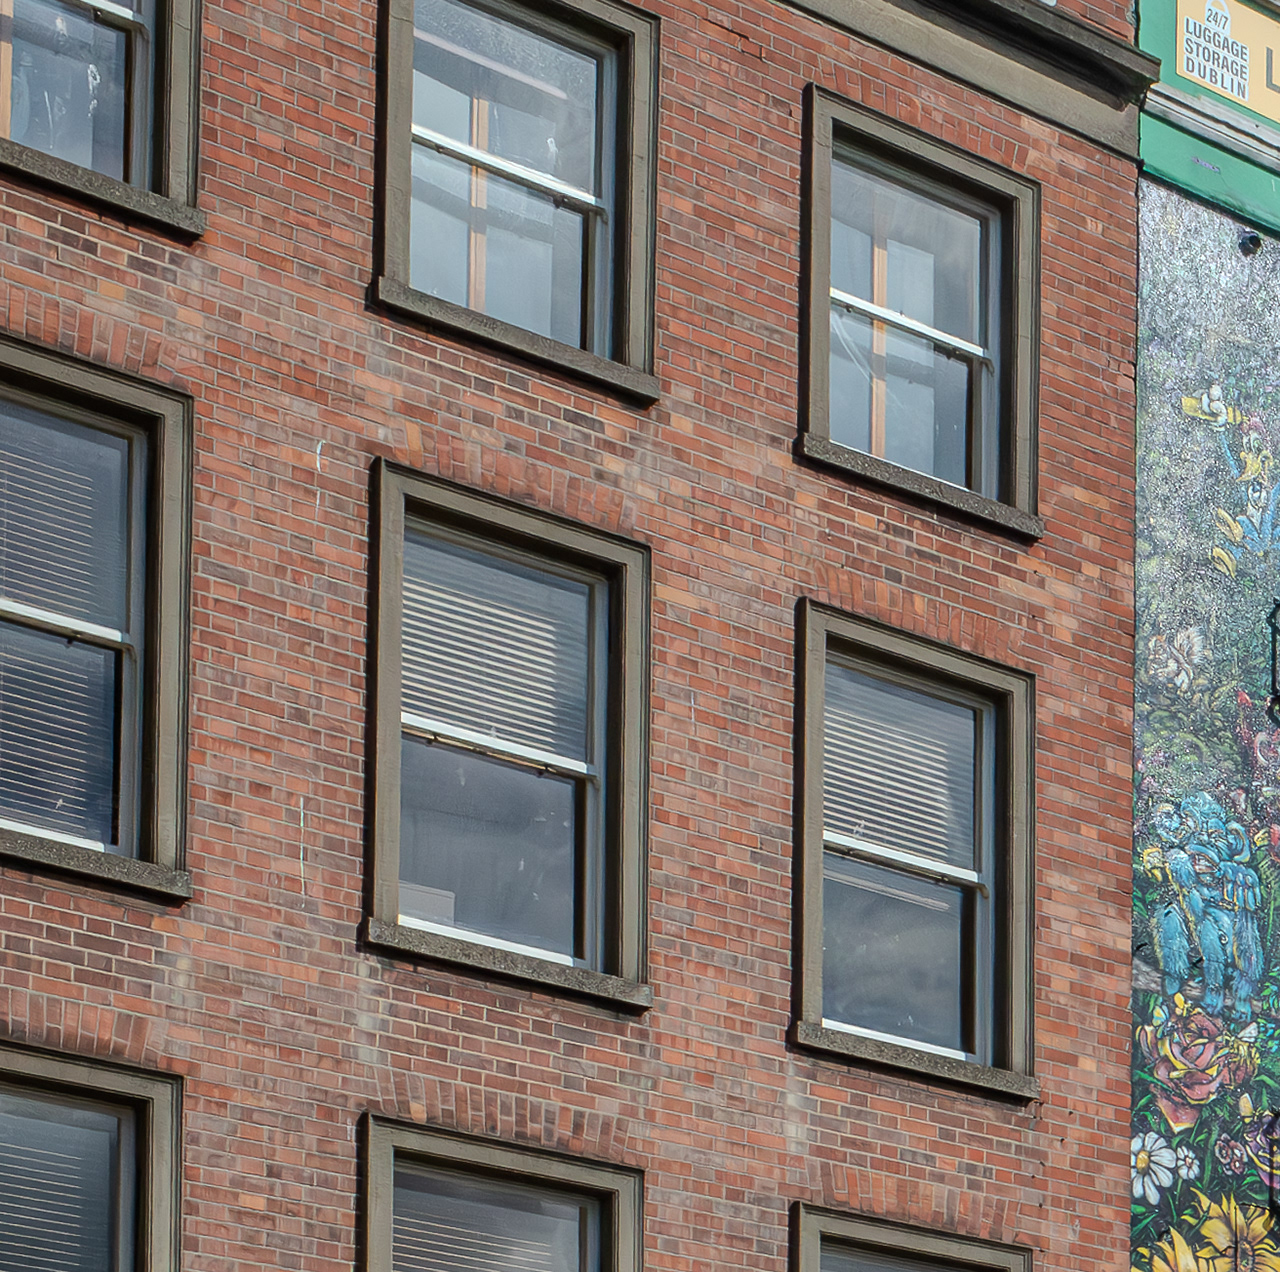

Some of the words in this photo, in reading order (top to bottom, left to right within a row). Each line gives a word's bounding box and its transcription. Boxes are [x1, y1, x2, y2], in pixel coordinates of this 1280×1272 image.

[1185, 18, 1248, 62] LUGGAGE
[1206, 8, 1229, 30] 24/7
[1184, 37, 1248, 82] STORAGE
[1186, 56, 1246, 99] DUBLIN
